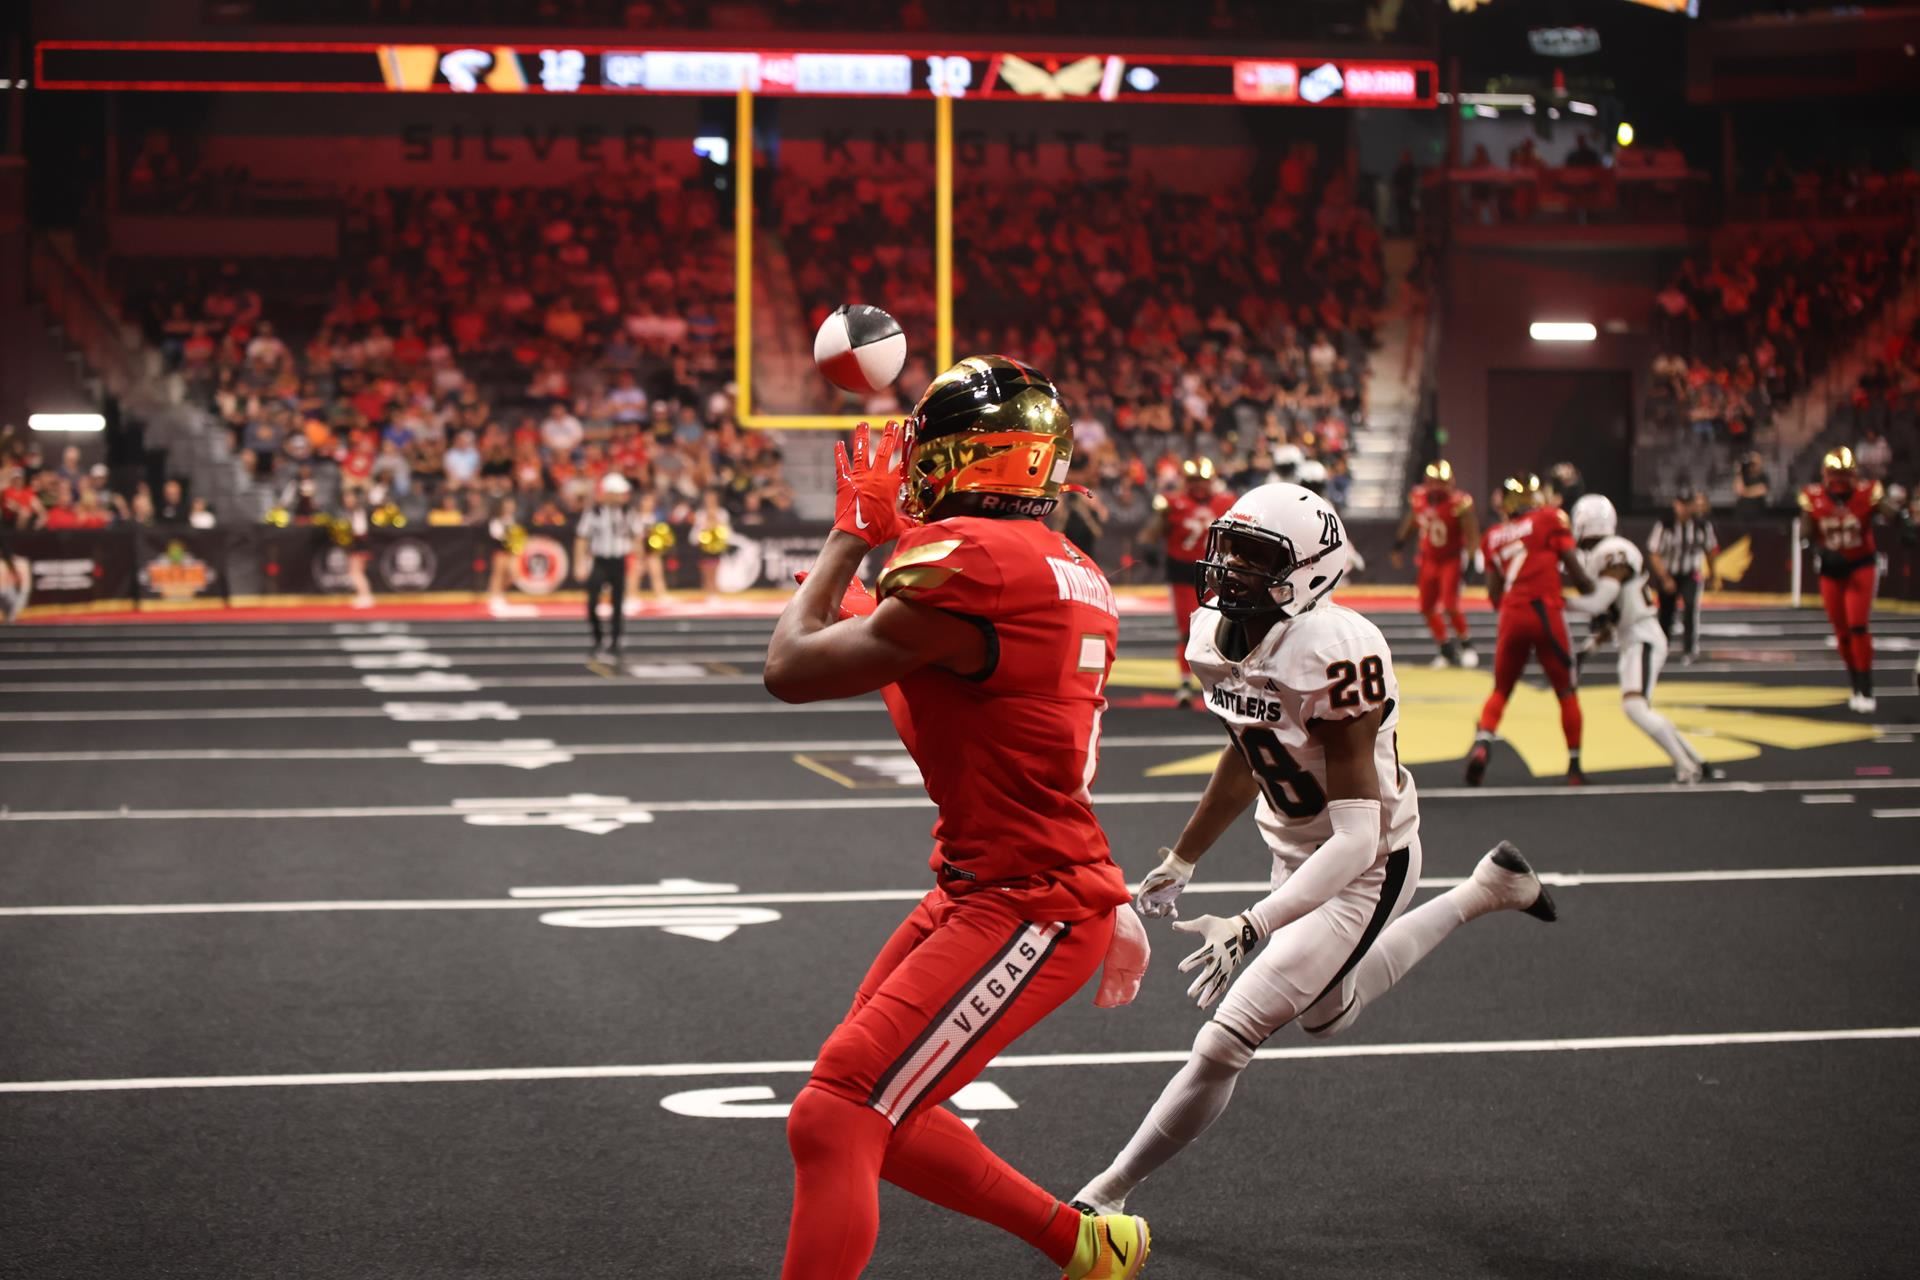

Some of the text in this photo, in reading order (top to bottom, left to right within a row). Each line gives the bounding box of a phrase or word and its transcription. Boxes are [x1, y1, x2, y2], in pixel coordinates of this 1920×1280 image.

[403, 125, 656, 161] SILVER
[1032, 449, 1041, 465] 7
[983, 496, 1053, 515] Riddell
[1316, 509, 1341, 547] 28
[1326, 654, 1387, 710] 28
[1210, 684, 1282, 722] RATTLERS
[953, 942, 1037, 1033] VEGAS
